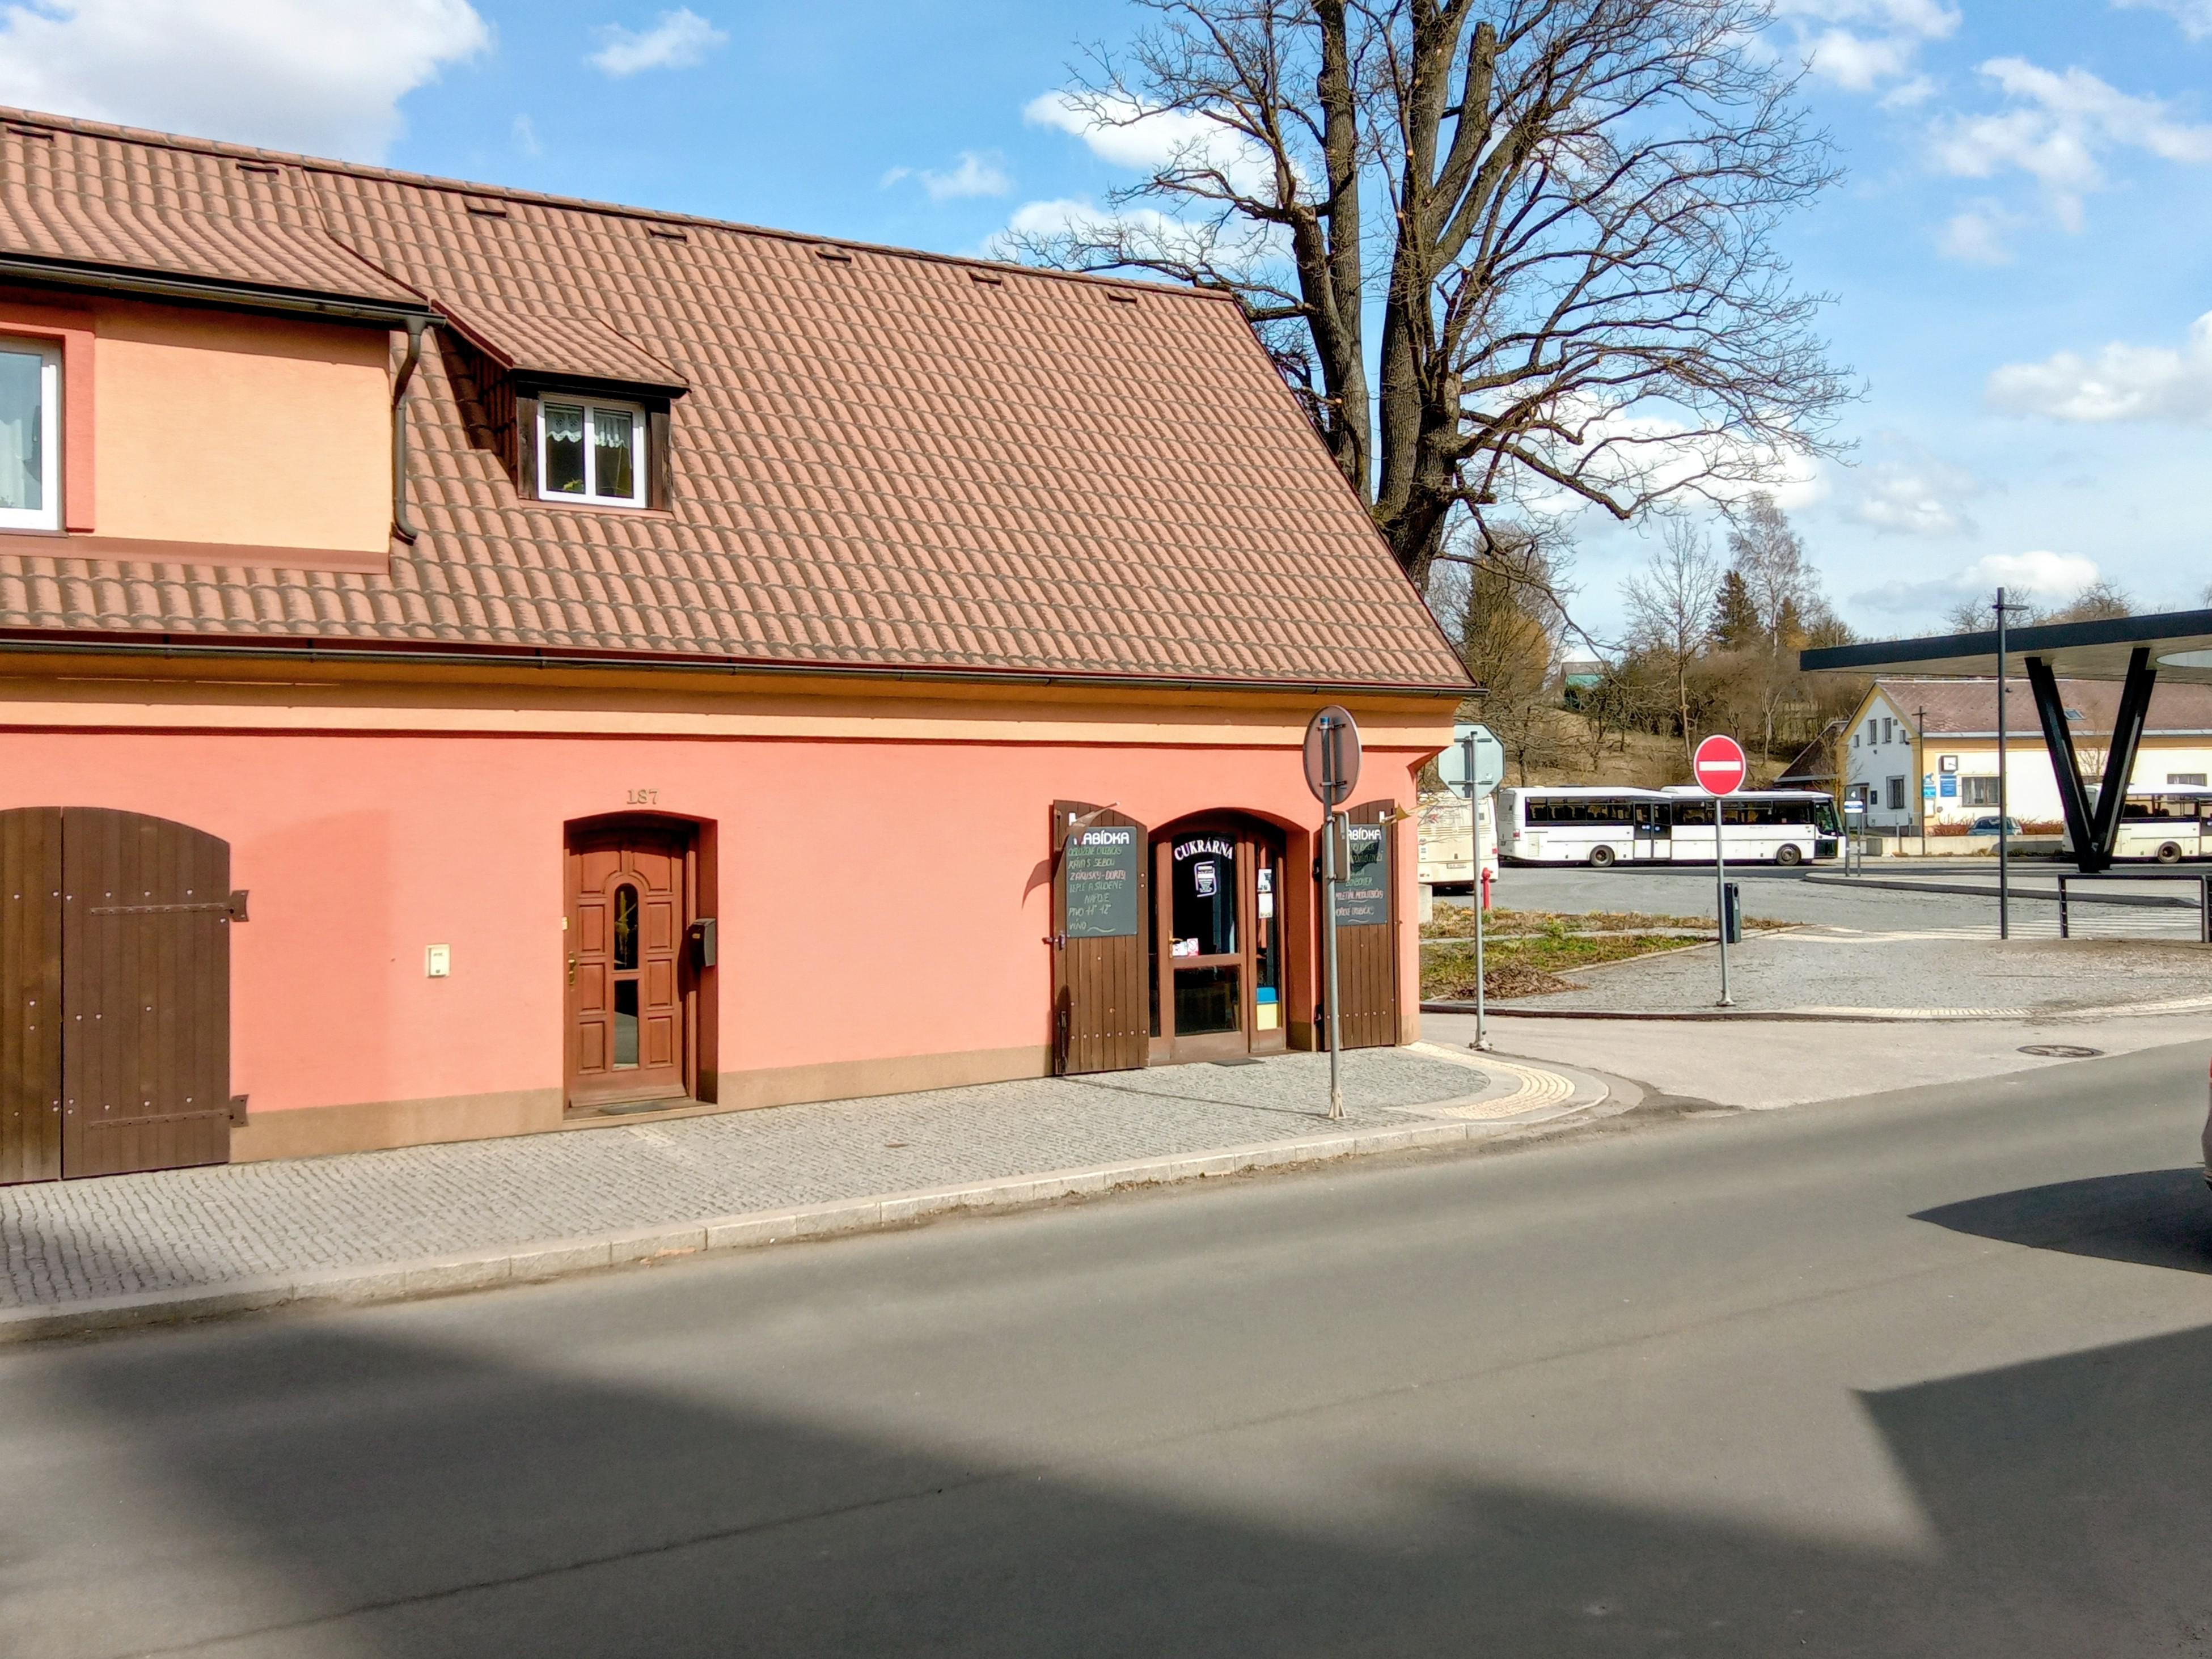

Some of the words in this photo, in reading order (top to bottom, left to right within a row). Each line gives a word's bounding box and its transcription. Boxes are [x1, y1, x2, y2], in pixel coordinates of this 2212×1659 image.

[626, 789, 659, 805] 187
[1348, 827, 1382, 840] ABÍDKA
[1174, 837, 1233, 861] CUKRÁRNA
[1069, 907, 1084, 916] PIVO
[1069, 918, 1087, 930] VÍNO
